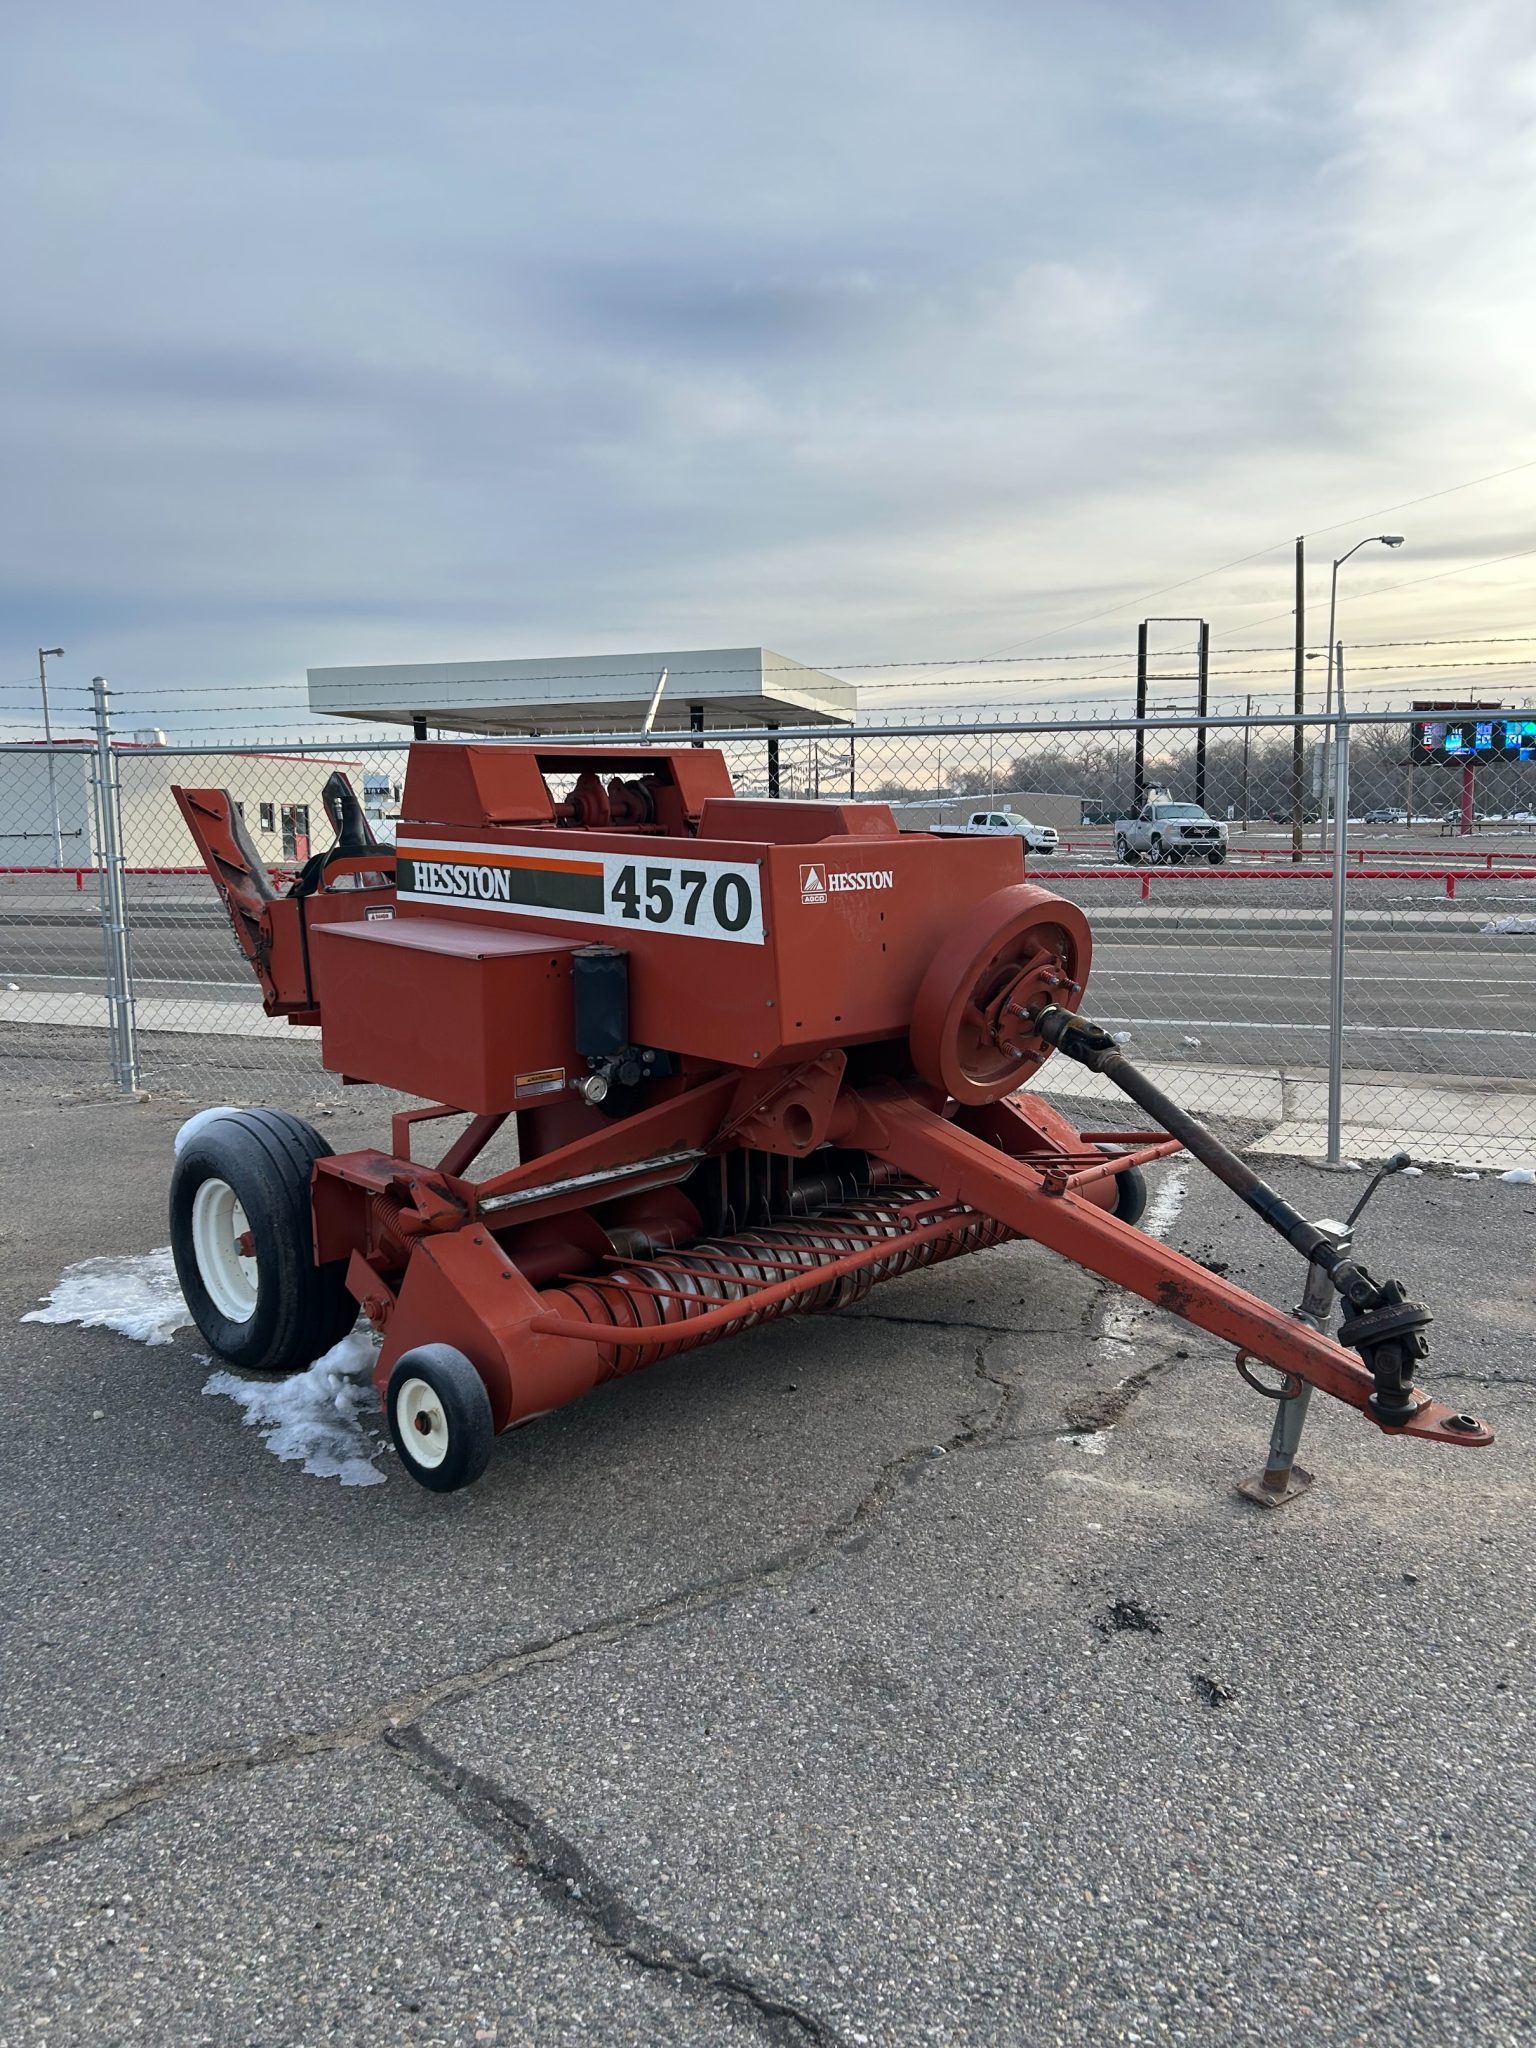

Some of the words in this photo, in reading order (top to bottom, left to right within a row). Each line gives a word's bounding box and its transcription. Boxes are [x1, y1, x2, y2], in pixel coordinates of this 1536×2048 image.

[412, 861, 511, 901] HESSTON
[611, 865, 753, 932] 4570
[828, 870, 893, 891] HESSTON
